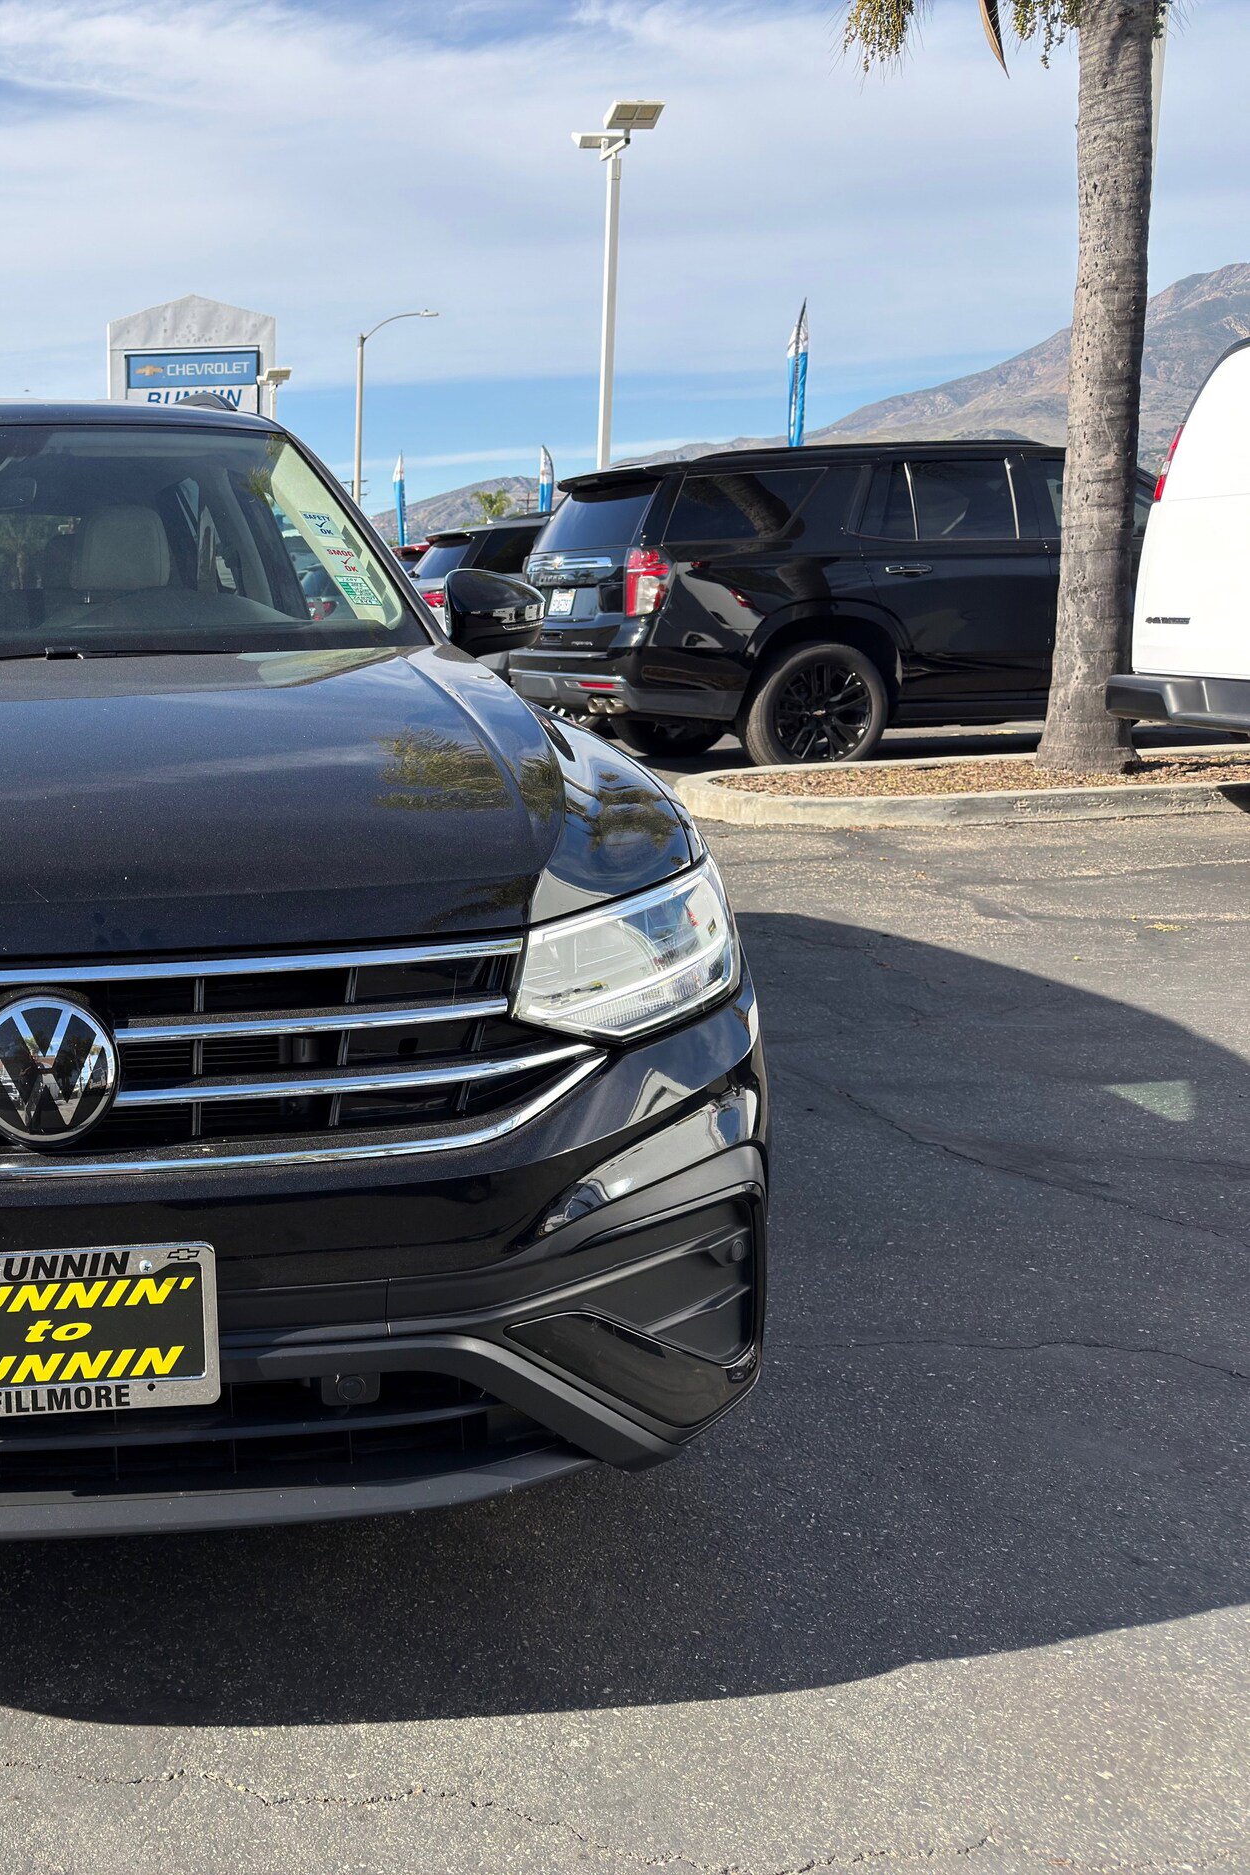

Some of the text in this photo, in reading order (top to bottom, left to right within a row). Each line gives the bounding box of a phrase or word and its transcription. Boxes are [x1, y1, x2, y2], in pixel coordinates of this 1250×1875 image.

[166, 362, 250, 376] CHEVROLET
[302, 513, 331, 521] SAFETY
[326, 549, 355, 557] SMOG
[24, 1319, 93, 1343] to
